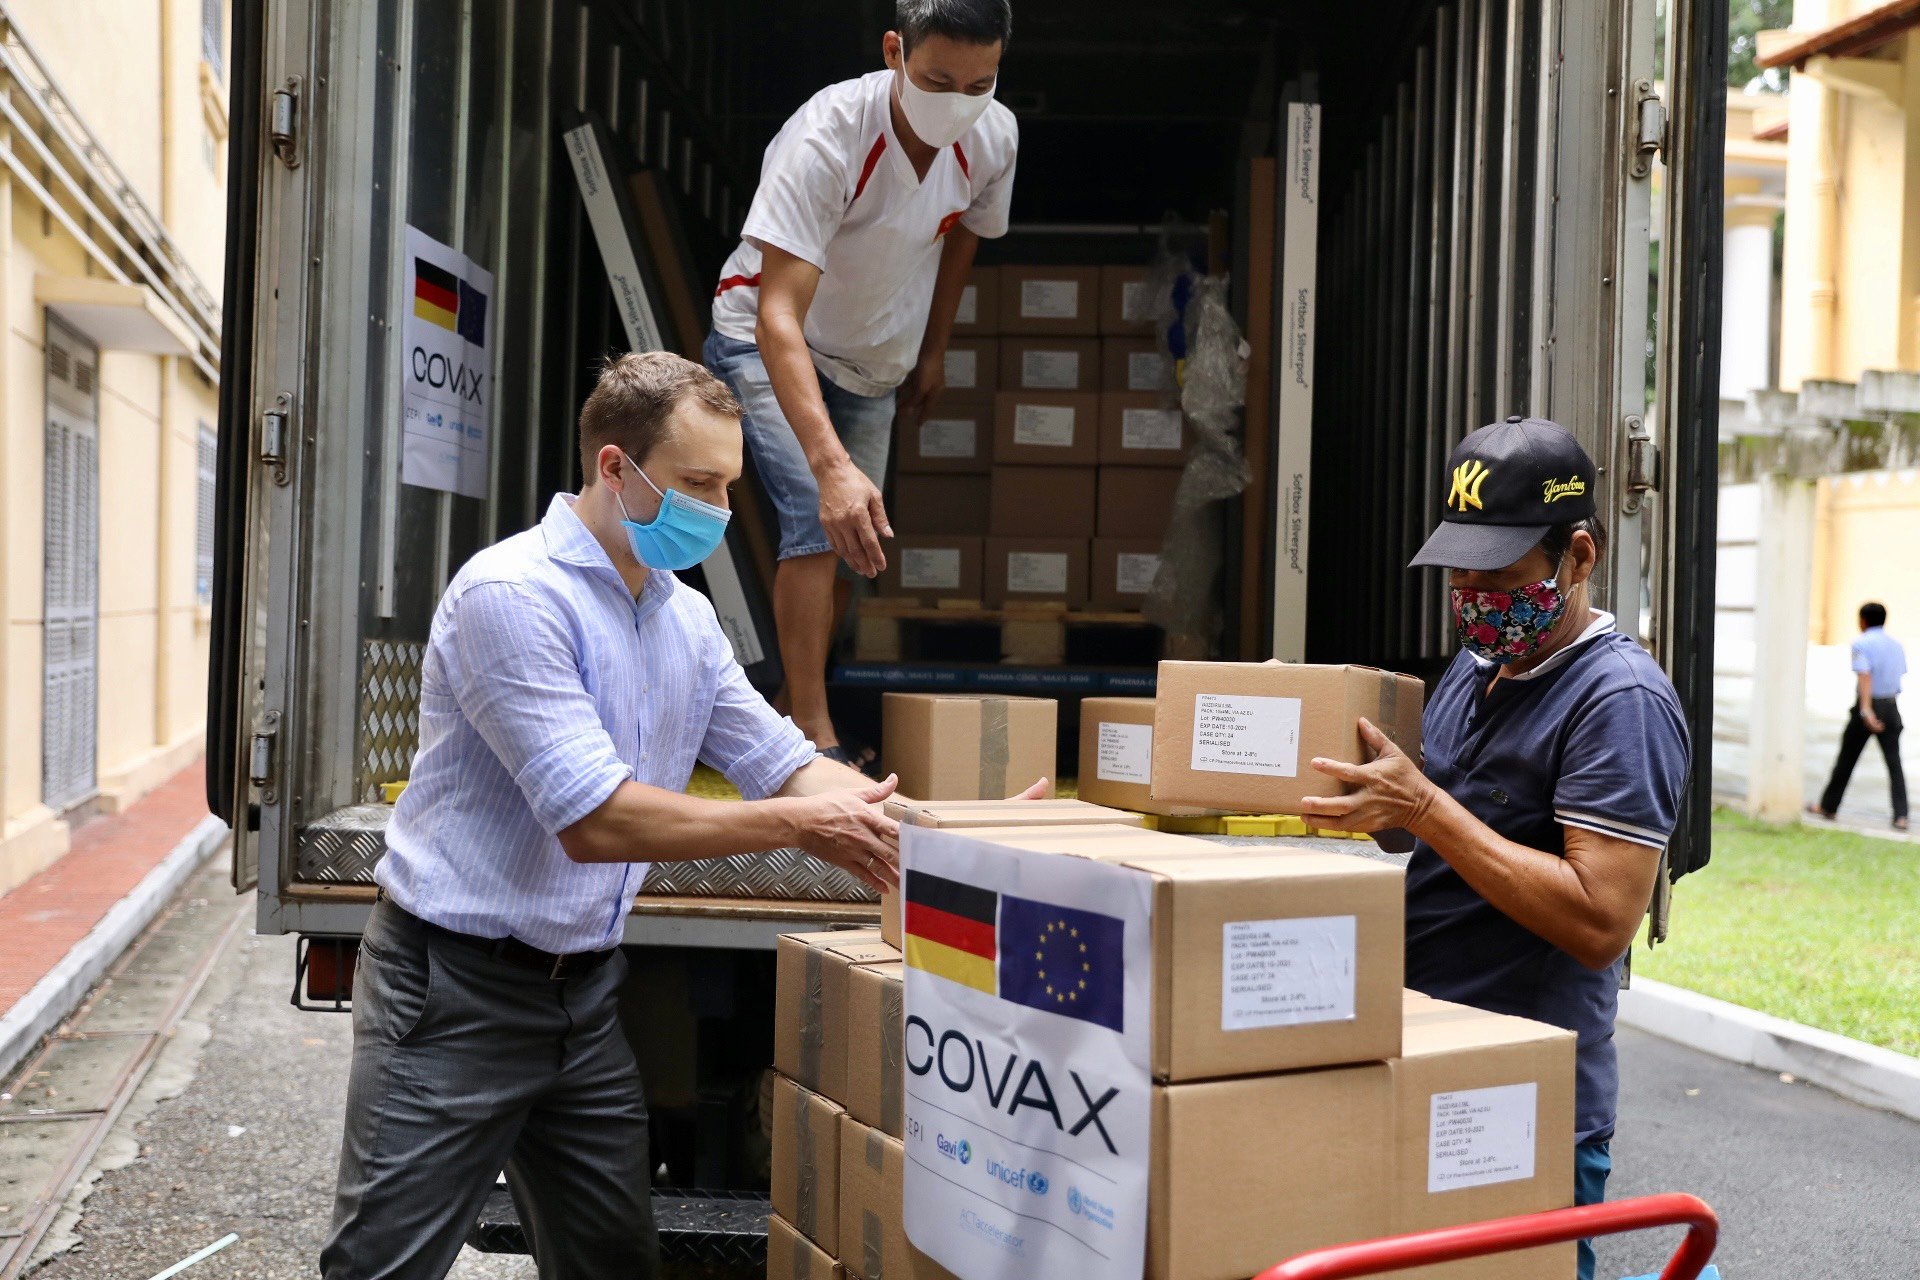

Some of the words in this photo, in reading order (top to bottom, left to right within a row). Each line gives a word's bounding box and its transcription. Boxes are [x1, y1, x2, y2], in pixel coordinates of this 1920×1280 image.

[1297, 287, 1308, 330] Softbox
[412, 346, 483, 406] COVAX
[1293, 473, 1303, 514] Softbox
[1199, 739, 1231, 747] SERIALISED
[1231, 983, 1272, 993] SERIALISED
[904, 1014, 1120, 1157] COVAX
[936, 1133, 957, 1156] Gavi
[986, 1157, 1026, 1190] unicef
[1435, 1140, 1450, 1148] CASE
[1435, 1148, 1469, 1159] SERIALISED
